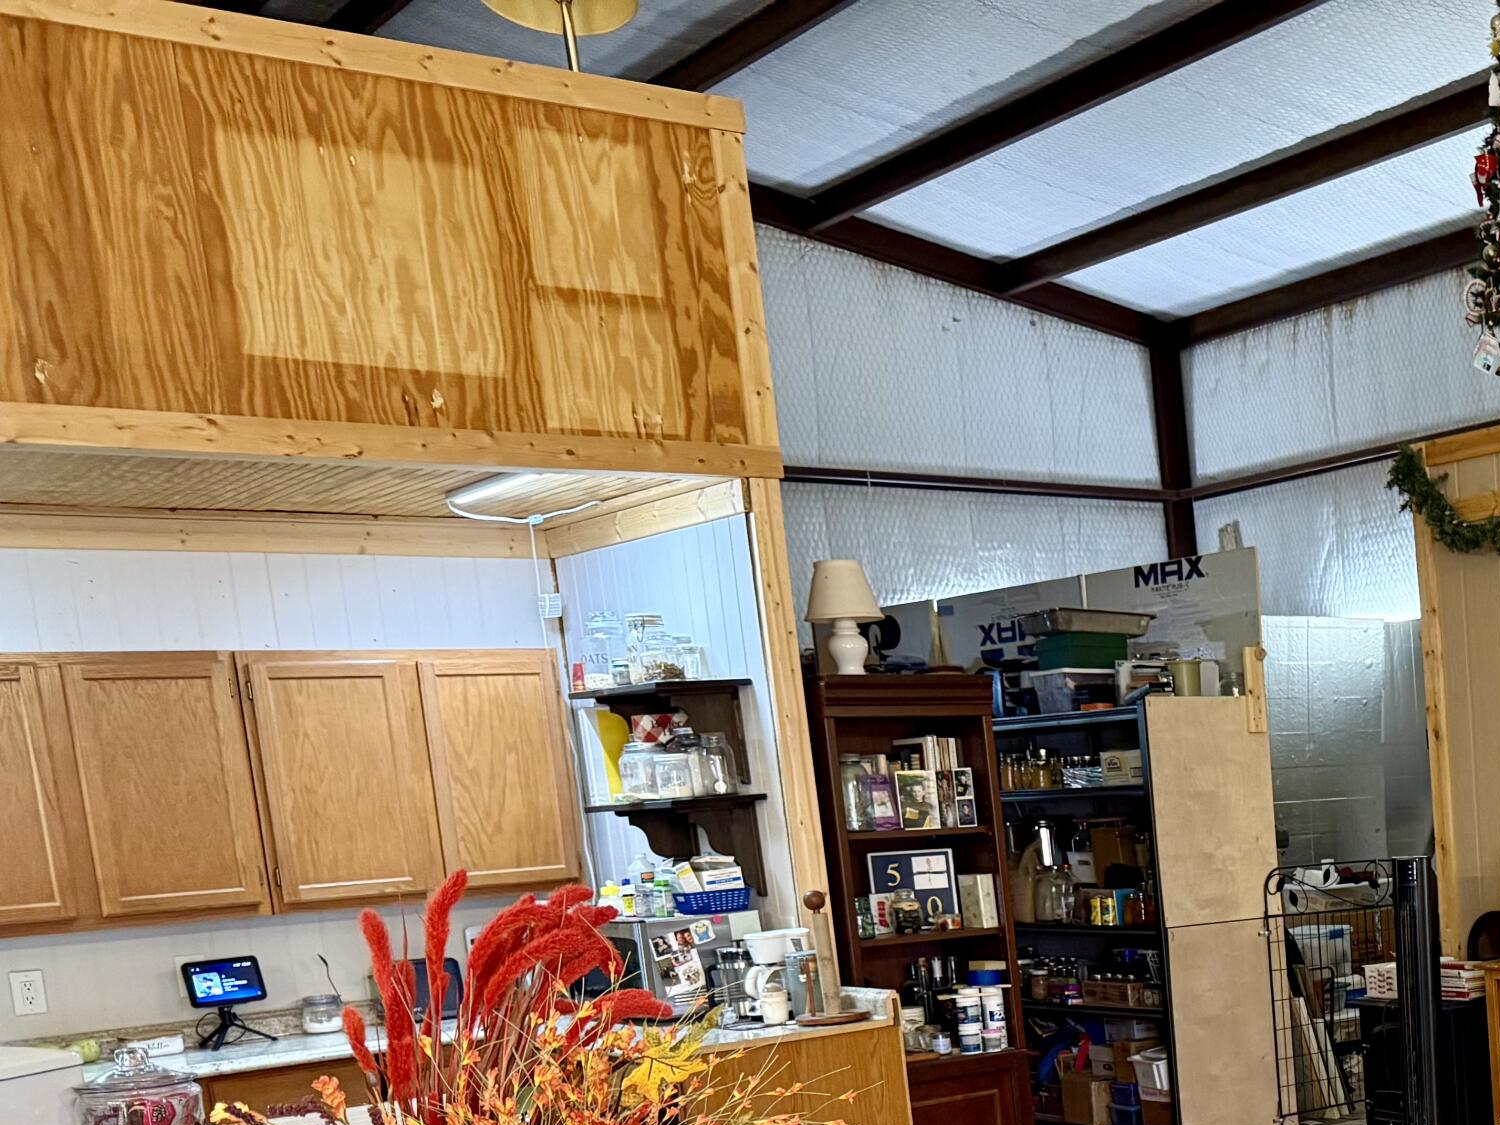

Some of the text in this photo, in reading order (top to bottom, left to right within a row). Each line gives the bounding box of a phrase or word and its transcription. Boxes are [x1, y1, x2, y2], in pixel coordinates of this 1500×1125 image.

[1134, 556, 1205, 588] MAX
[581, 653, 609, 664] OATS
[886, 863, 901, 887] 5
